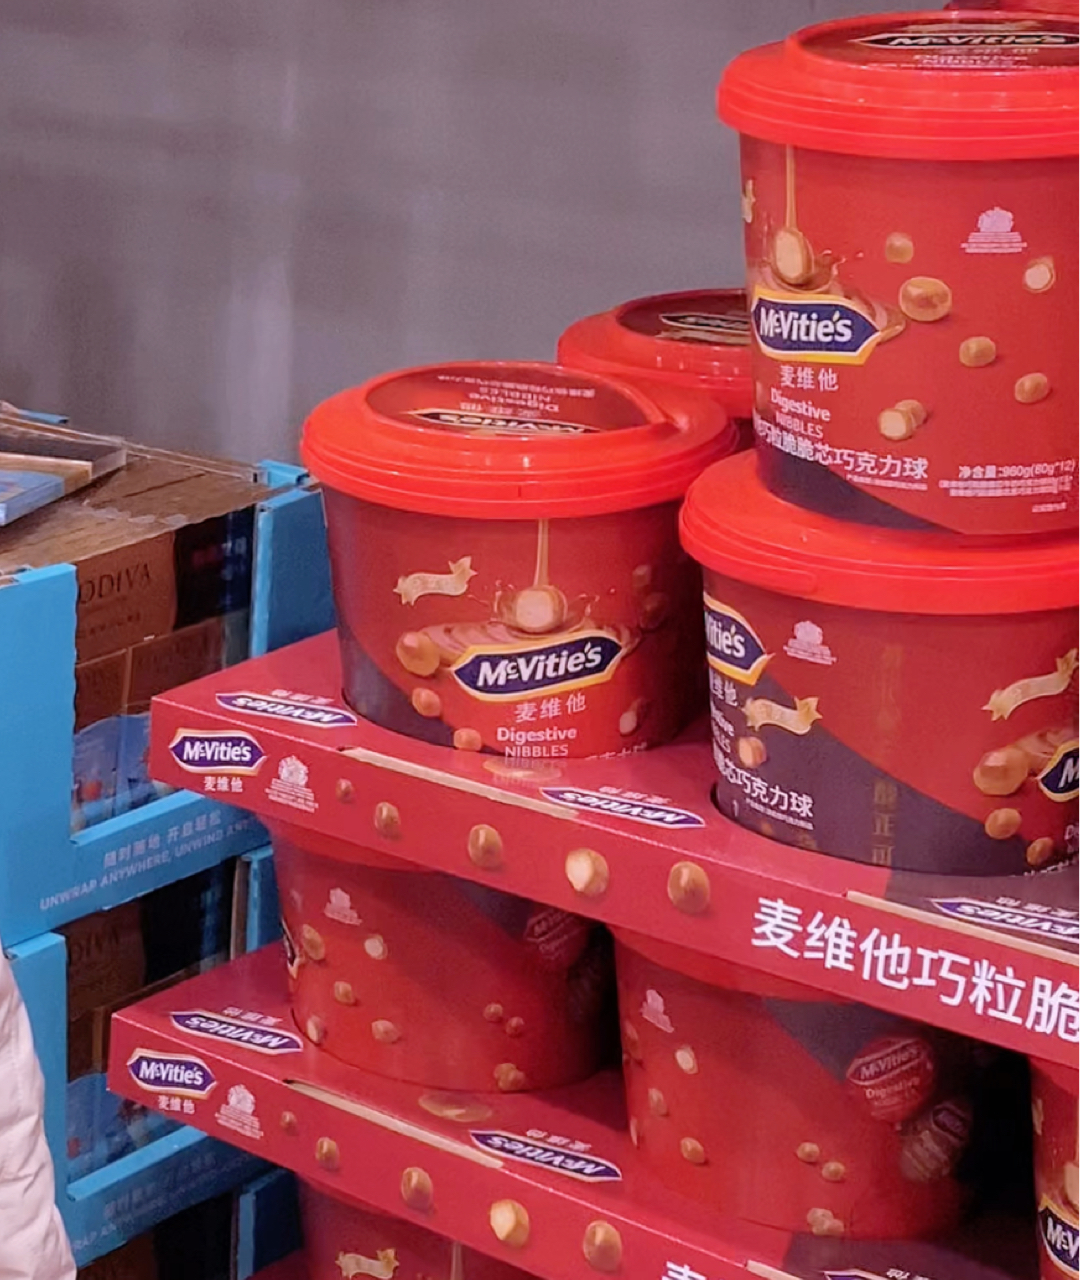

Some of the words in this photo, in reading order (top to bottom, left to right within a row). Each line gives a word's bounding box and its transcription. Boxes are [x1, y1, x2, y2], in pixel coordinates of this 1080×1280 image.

[760, 306, 852, 342] McVitie's
[780, 365, 839, 391] 麦维他
[771, 388, 831, 421] Digestive
[477, 642, 602, 686] McVitie's
[233, 697, 344, 723] McVitie's
[514, 693, 587, 723] 麦维他
[497, 726, 577, 745] Digestive
[505, 744, 569, 757] NIBBLES
[183, 740, 252, 762] McVitie's
[204, 776, 244, 793] 麦维他
[559, 792, 687, 822] McVitie's
[40, 878, 98, 910] UNWRAP
[175, 829, 224, 857] UNWIND
[750, 897, 1080, 1043] 麦维他巧粒脆
[187, 1016, 290, 1048] McVitie's
[139, 1060, 204, 1086] McVitie's
[487, 1135, 606, 1175] McVitie's
